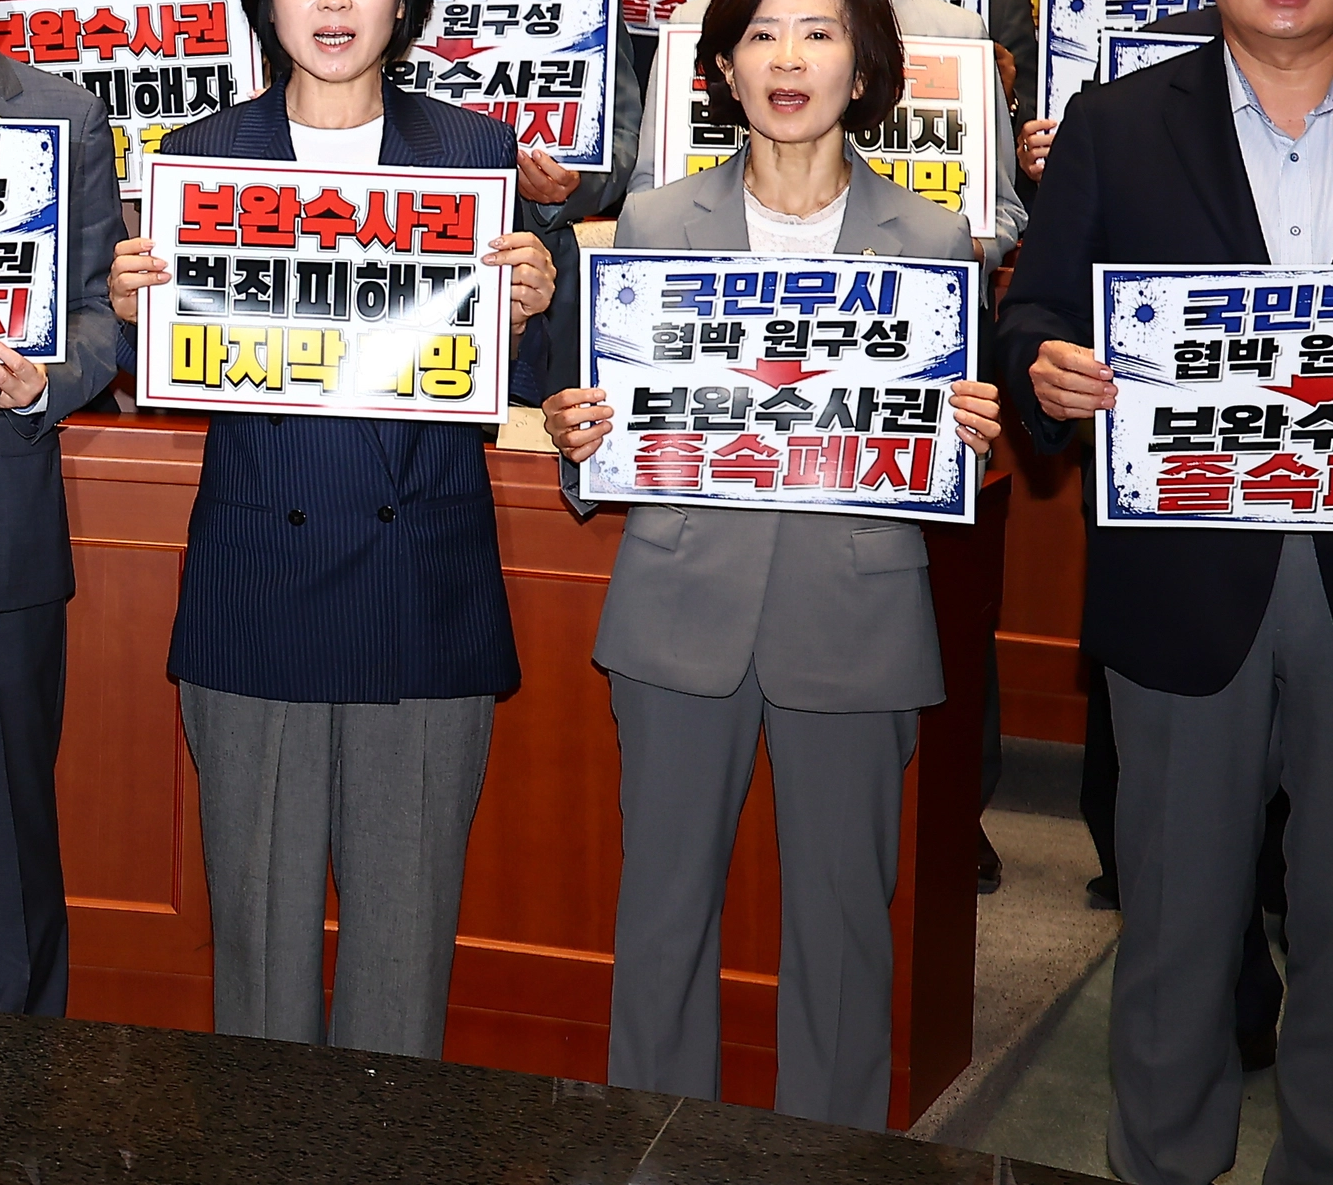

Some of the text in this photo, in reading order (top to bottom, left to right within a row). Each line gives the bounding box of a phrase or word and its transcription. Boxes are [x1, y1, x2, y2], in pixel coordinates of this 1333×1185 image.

[443, 3, 562, 37] 원구성
[63, 64, 236, 117] 피해자
[176, 181, 479, 256] 보완수사권
[661, 271, 899, 316] 국민무시
[170, 322, 349, 393] 마지막
[651, 319, 910, 361] 협박 원구성
[1173, 337, 1280, 380] 협박
[627, 387, 941, 433] 보완수사권
[634, 434, 933, 491] 졸속폐지
[1156, 453, 1333, 513] 졸속
